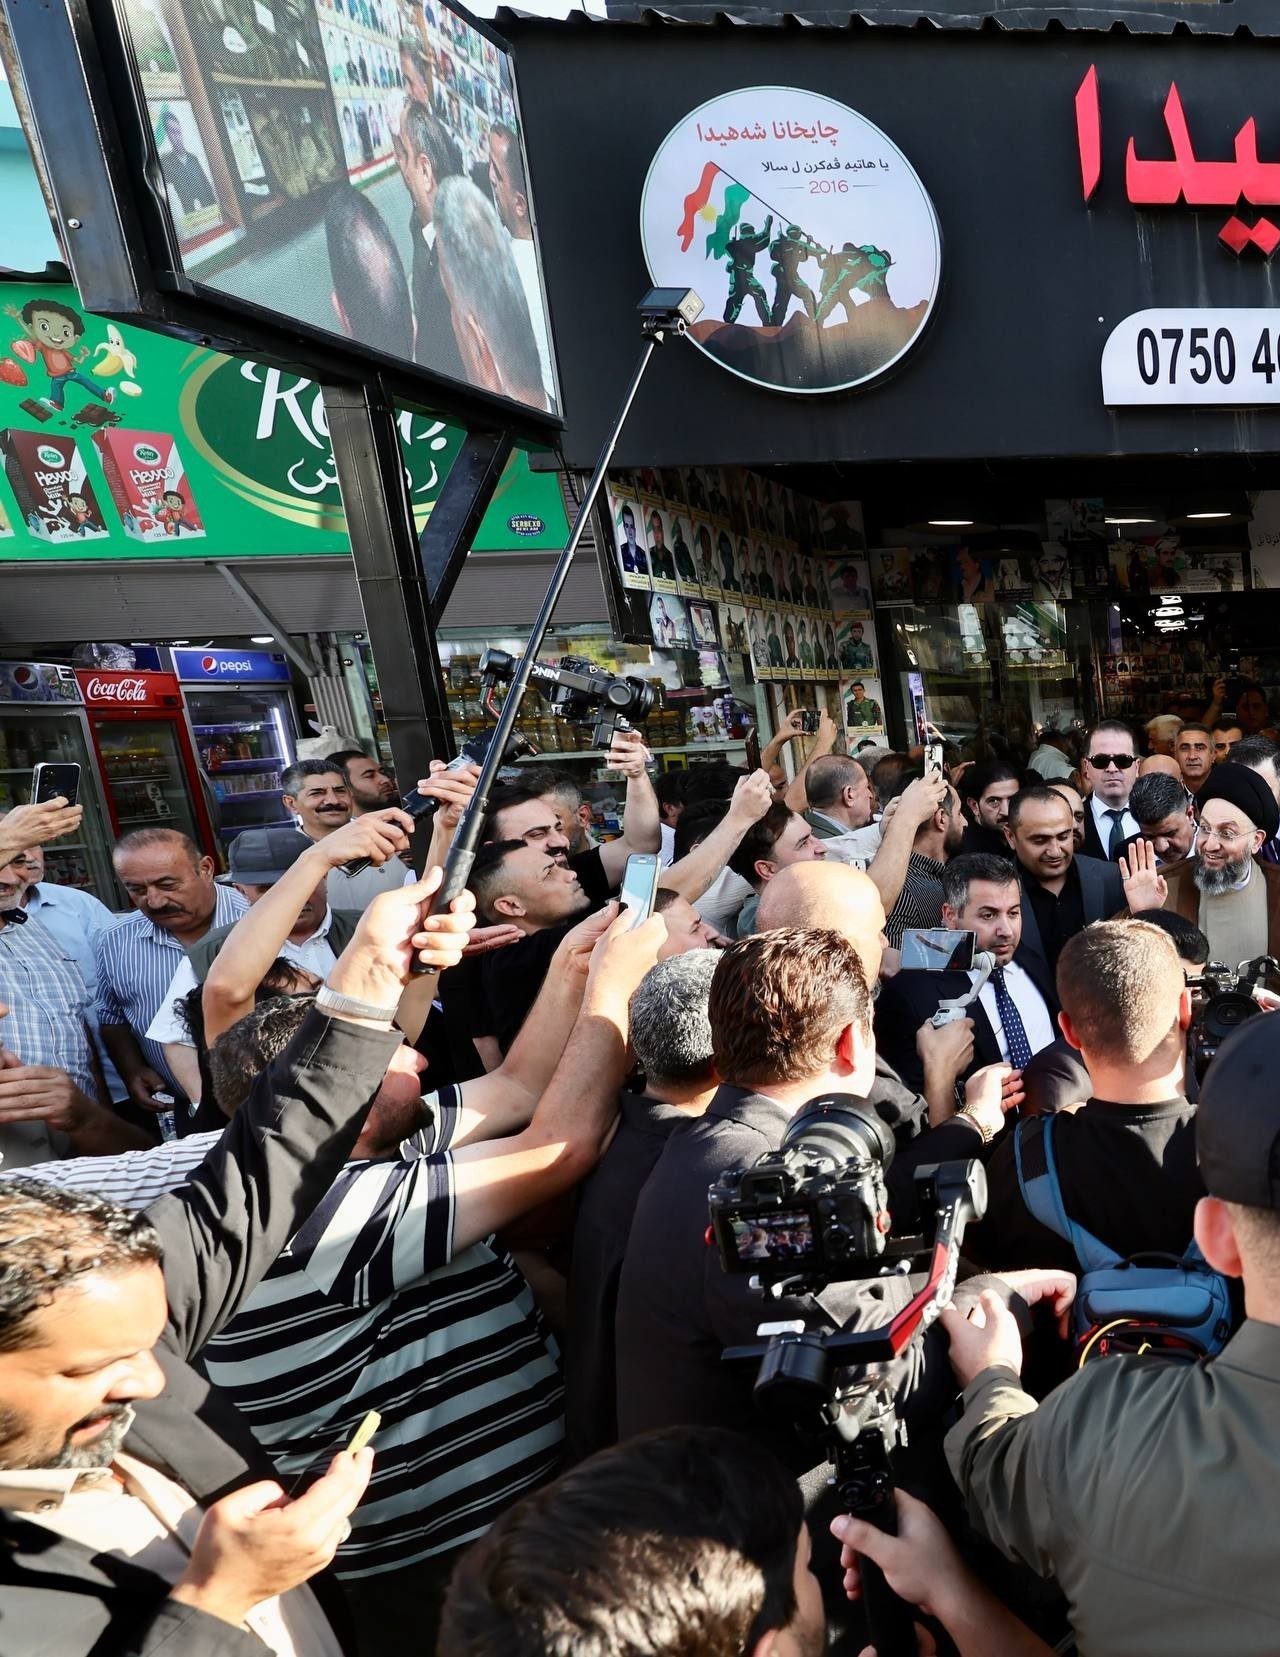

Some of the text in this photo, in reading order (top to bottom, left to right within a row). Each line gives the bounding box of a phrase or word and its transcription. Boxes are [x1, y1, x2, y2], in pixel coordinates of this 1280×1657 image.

[772, 120, 839, 146] چایخانا
[808, 180, 849, 194] 2016
[1136, 327, 1237, 385] 0750
[219, 659, 253, 674] pepsi
